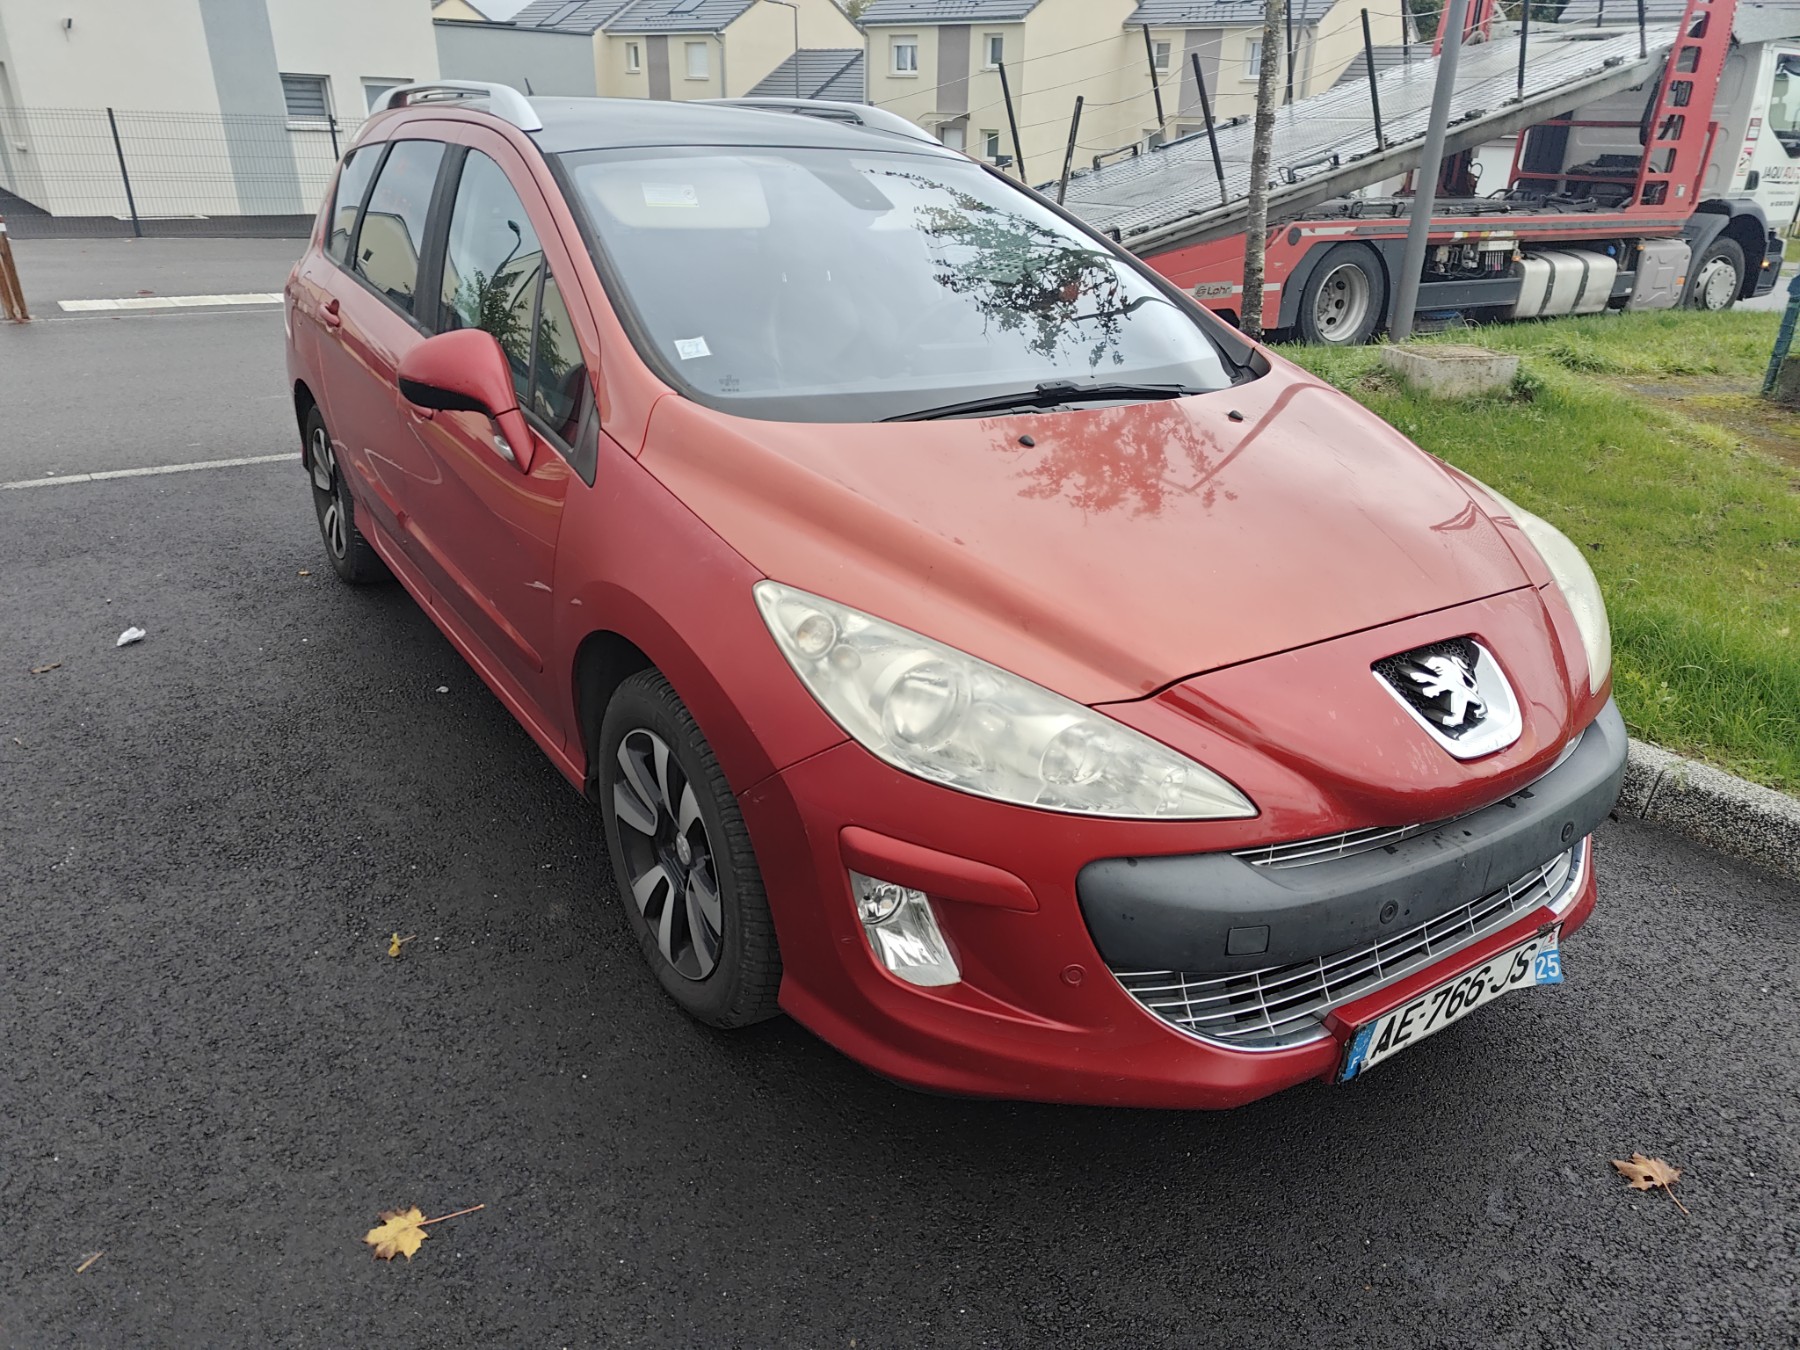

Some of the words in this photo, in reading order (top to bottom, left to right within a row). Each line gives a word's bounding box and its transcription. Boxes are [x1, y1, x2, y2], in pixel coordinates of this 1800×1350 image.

[1350, 1055, 1361, 1069] F
[1369, 943, 1538, 1060] AE-766-JS
[1535, 953, 1560, 980] 25
